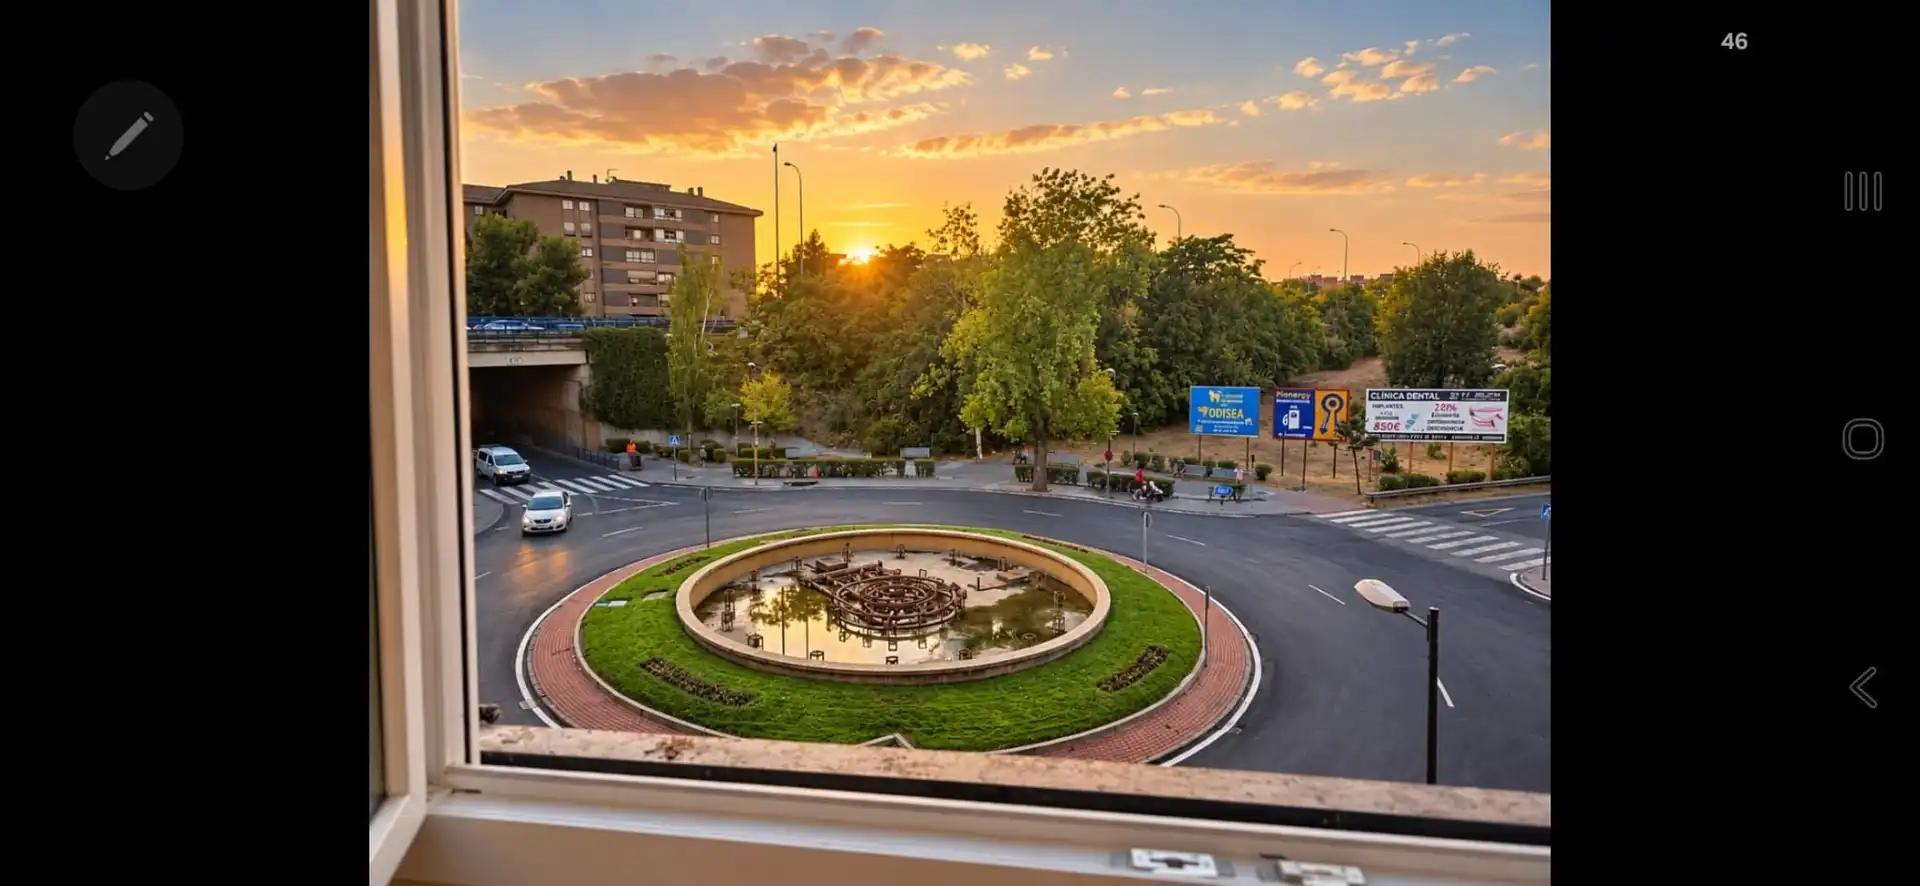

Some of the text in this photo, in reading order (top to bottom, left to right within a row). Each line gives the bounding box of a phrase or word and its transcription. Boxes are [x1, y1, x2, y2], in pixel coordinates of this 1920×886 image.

[1406, 392, 1441, 400] DENTAL
[1208, 408, 1244, 419] ODISEA
[1373, 422, 1401, 431] 850€
